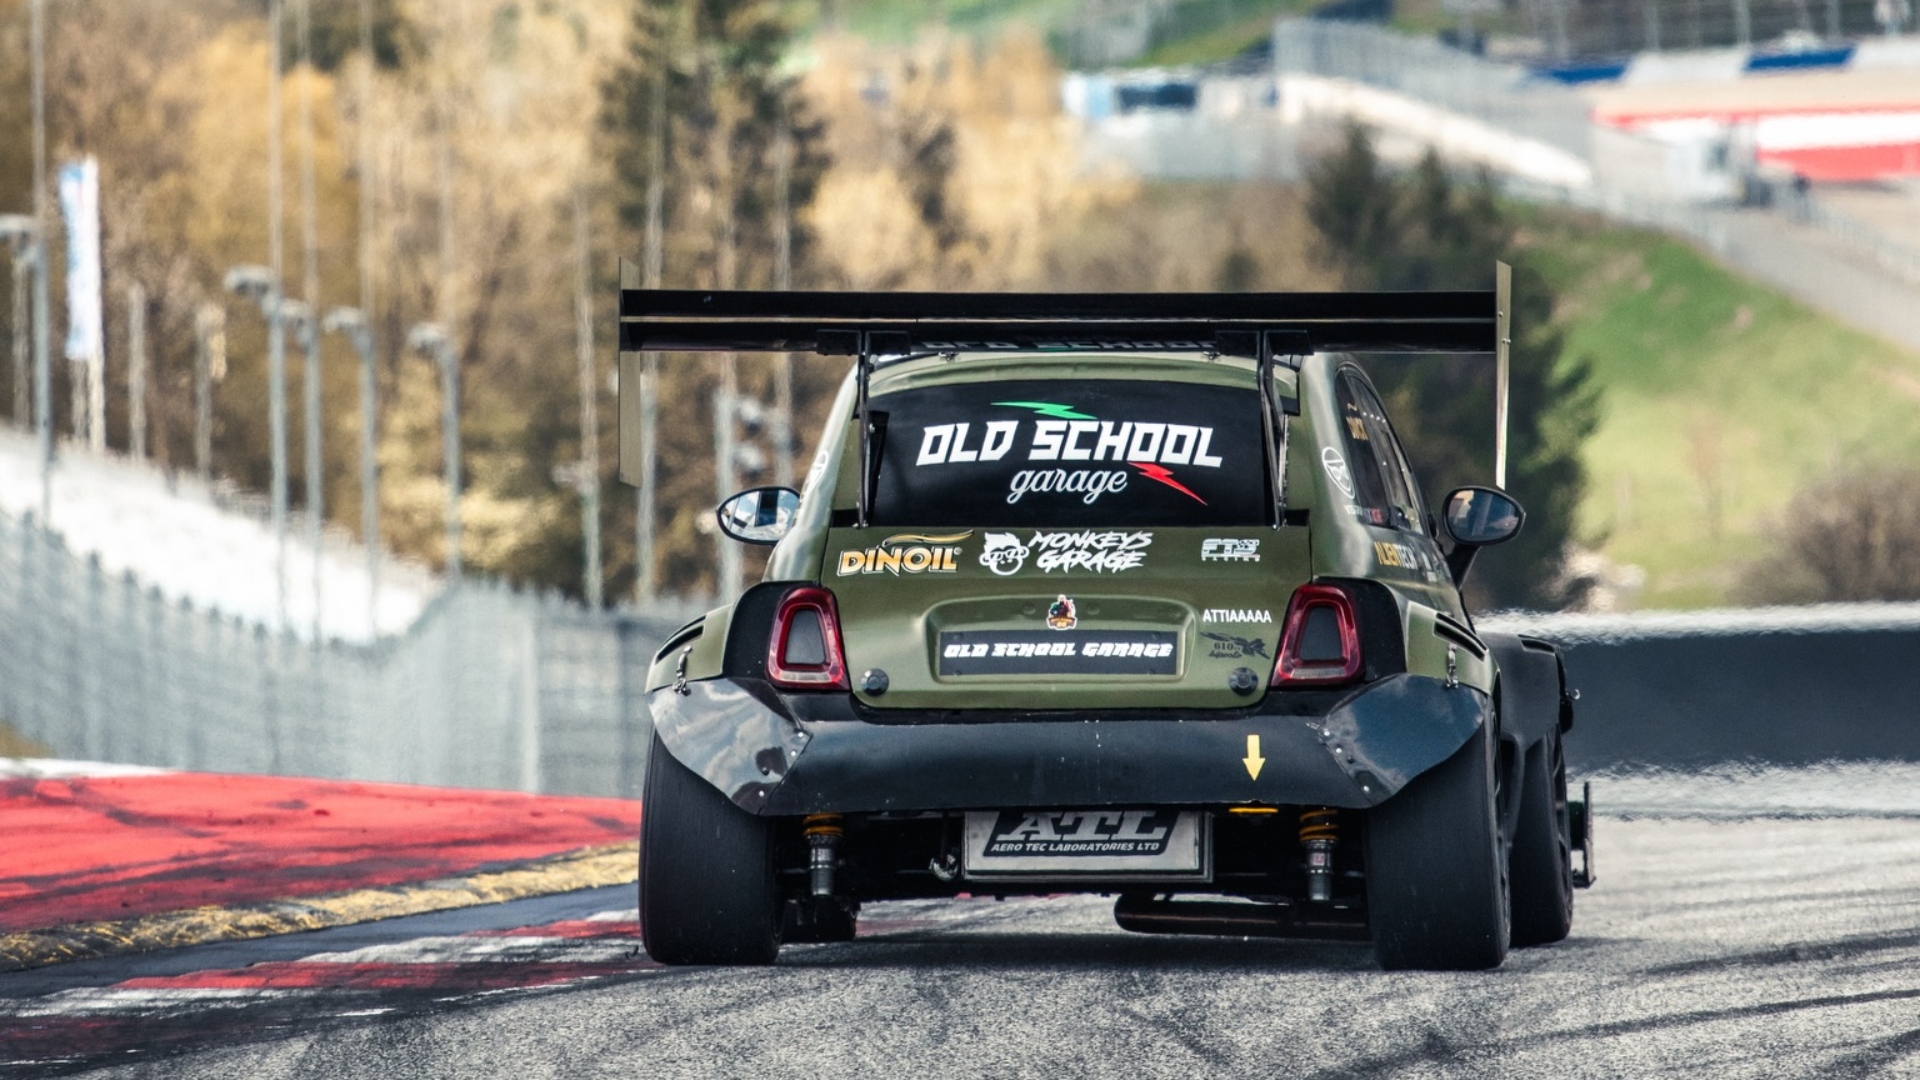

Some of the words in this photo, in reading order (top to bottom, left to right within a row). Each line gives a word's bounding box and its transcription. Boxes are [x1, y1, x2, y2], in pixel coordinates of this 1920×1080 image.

[916, 420, 1018, 466] OLD
[1028, 420, 1223, 467] SCHOOL
[1006, 466, 1127, 504] garage
[1028, 529, 1153, 552] MONKEYS
[837, 545, 957, 577] DINOIL
[1036, 548, 1147, 574] GARAGE
[1202, 609, 1272, 623] ATTIAAAAA
[943, 643, 989, 658] OLD
[991, 643, 1076, 658] SCHOOL
[1082, 643, 1173, 658] GARAGE
[996, 811, 1167, 841] ATL
[990, 842, 1024, 853] AERO
[1025, 842, 1047, 853] TEC
[1049, 841, 1135, 852] LABORATORIES
[1137, 841, 1160, 852] LTD
